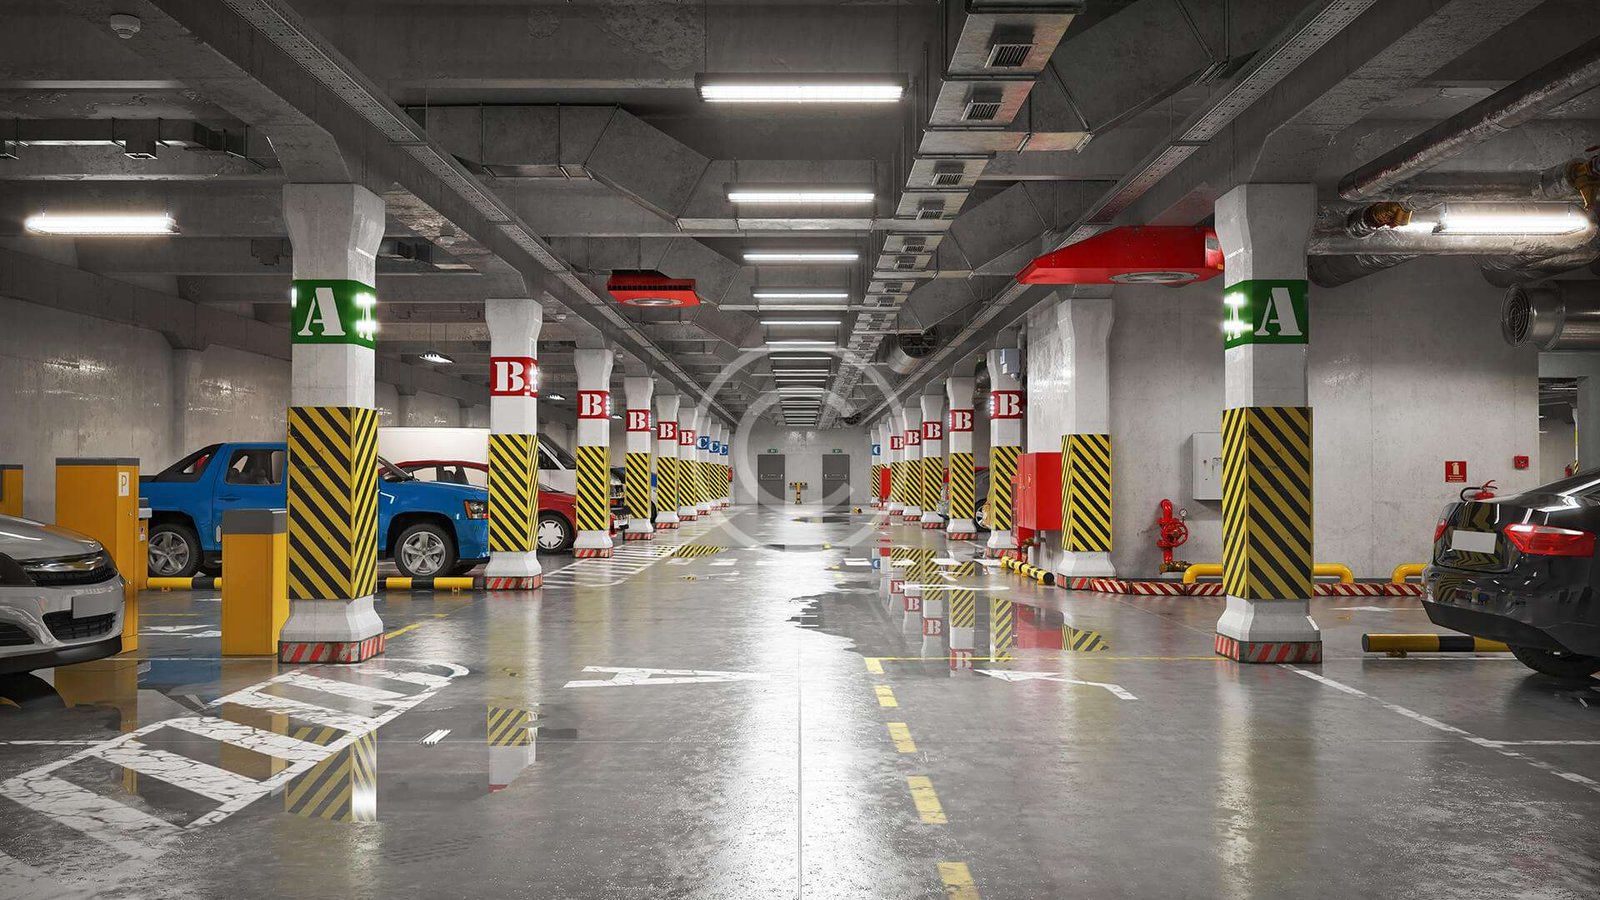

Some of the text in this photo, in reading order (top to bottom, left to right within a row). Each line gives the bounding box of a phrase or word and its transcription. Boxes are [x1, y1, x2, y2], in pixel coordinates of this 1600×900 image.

[298, 288, 346, 336] A
[1254, 287, 1303, 336] A
[494, 361, 525, 392] B
[580, 393, 602, 416] B
[998, 393, 1020, 416] B
[628, 411, 646, 430] B
[955, 411, 972, 430] B
[659, 423, 674, 438] B
[680, 431, 693, 444] B
[907, 431, 920, 444] B
[927, 423, 941, 438] B
[696, 437, 708, 449] C
[708, 441, 719, 452] C
[720, 445, 727, 455] C
[893, 437, 904, 449] B
[121, 475, 128, 493] P
